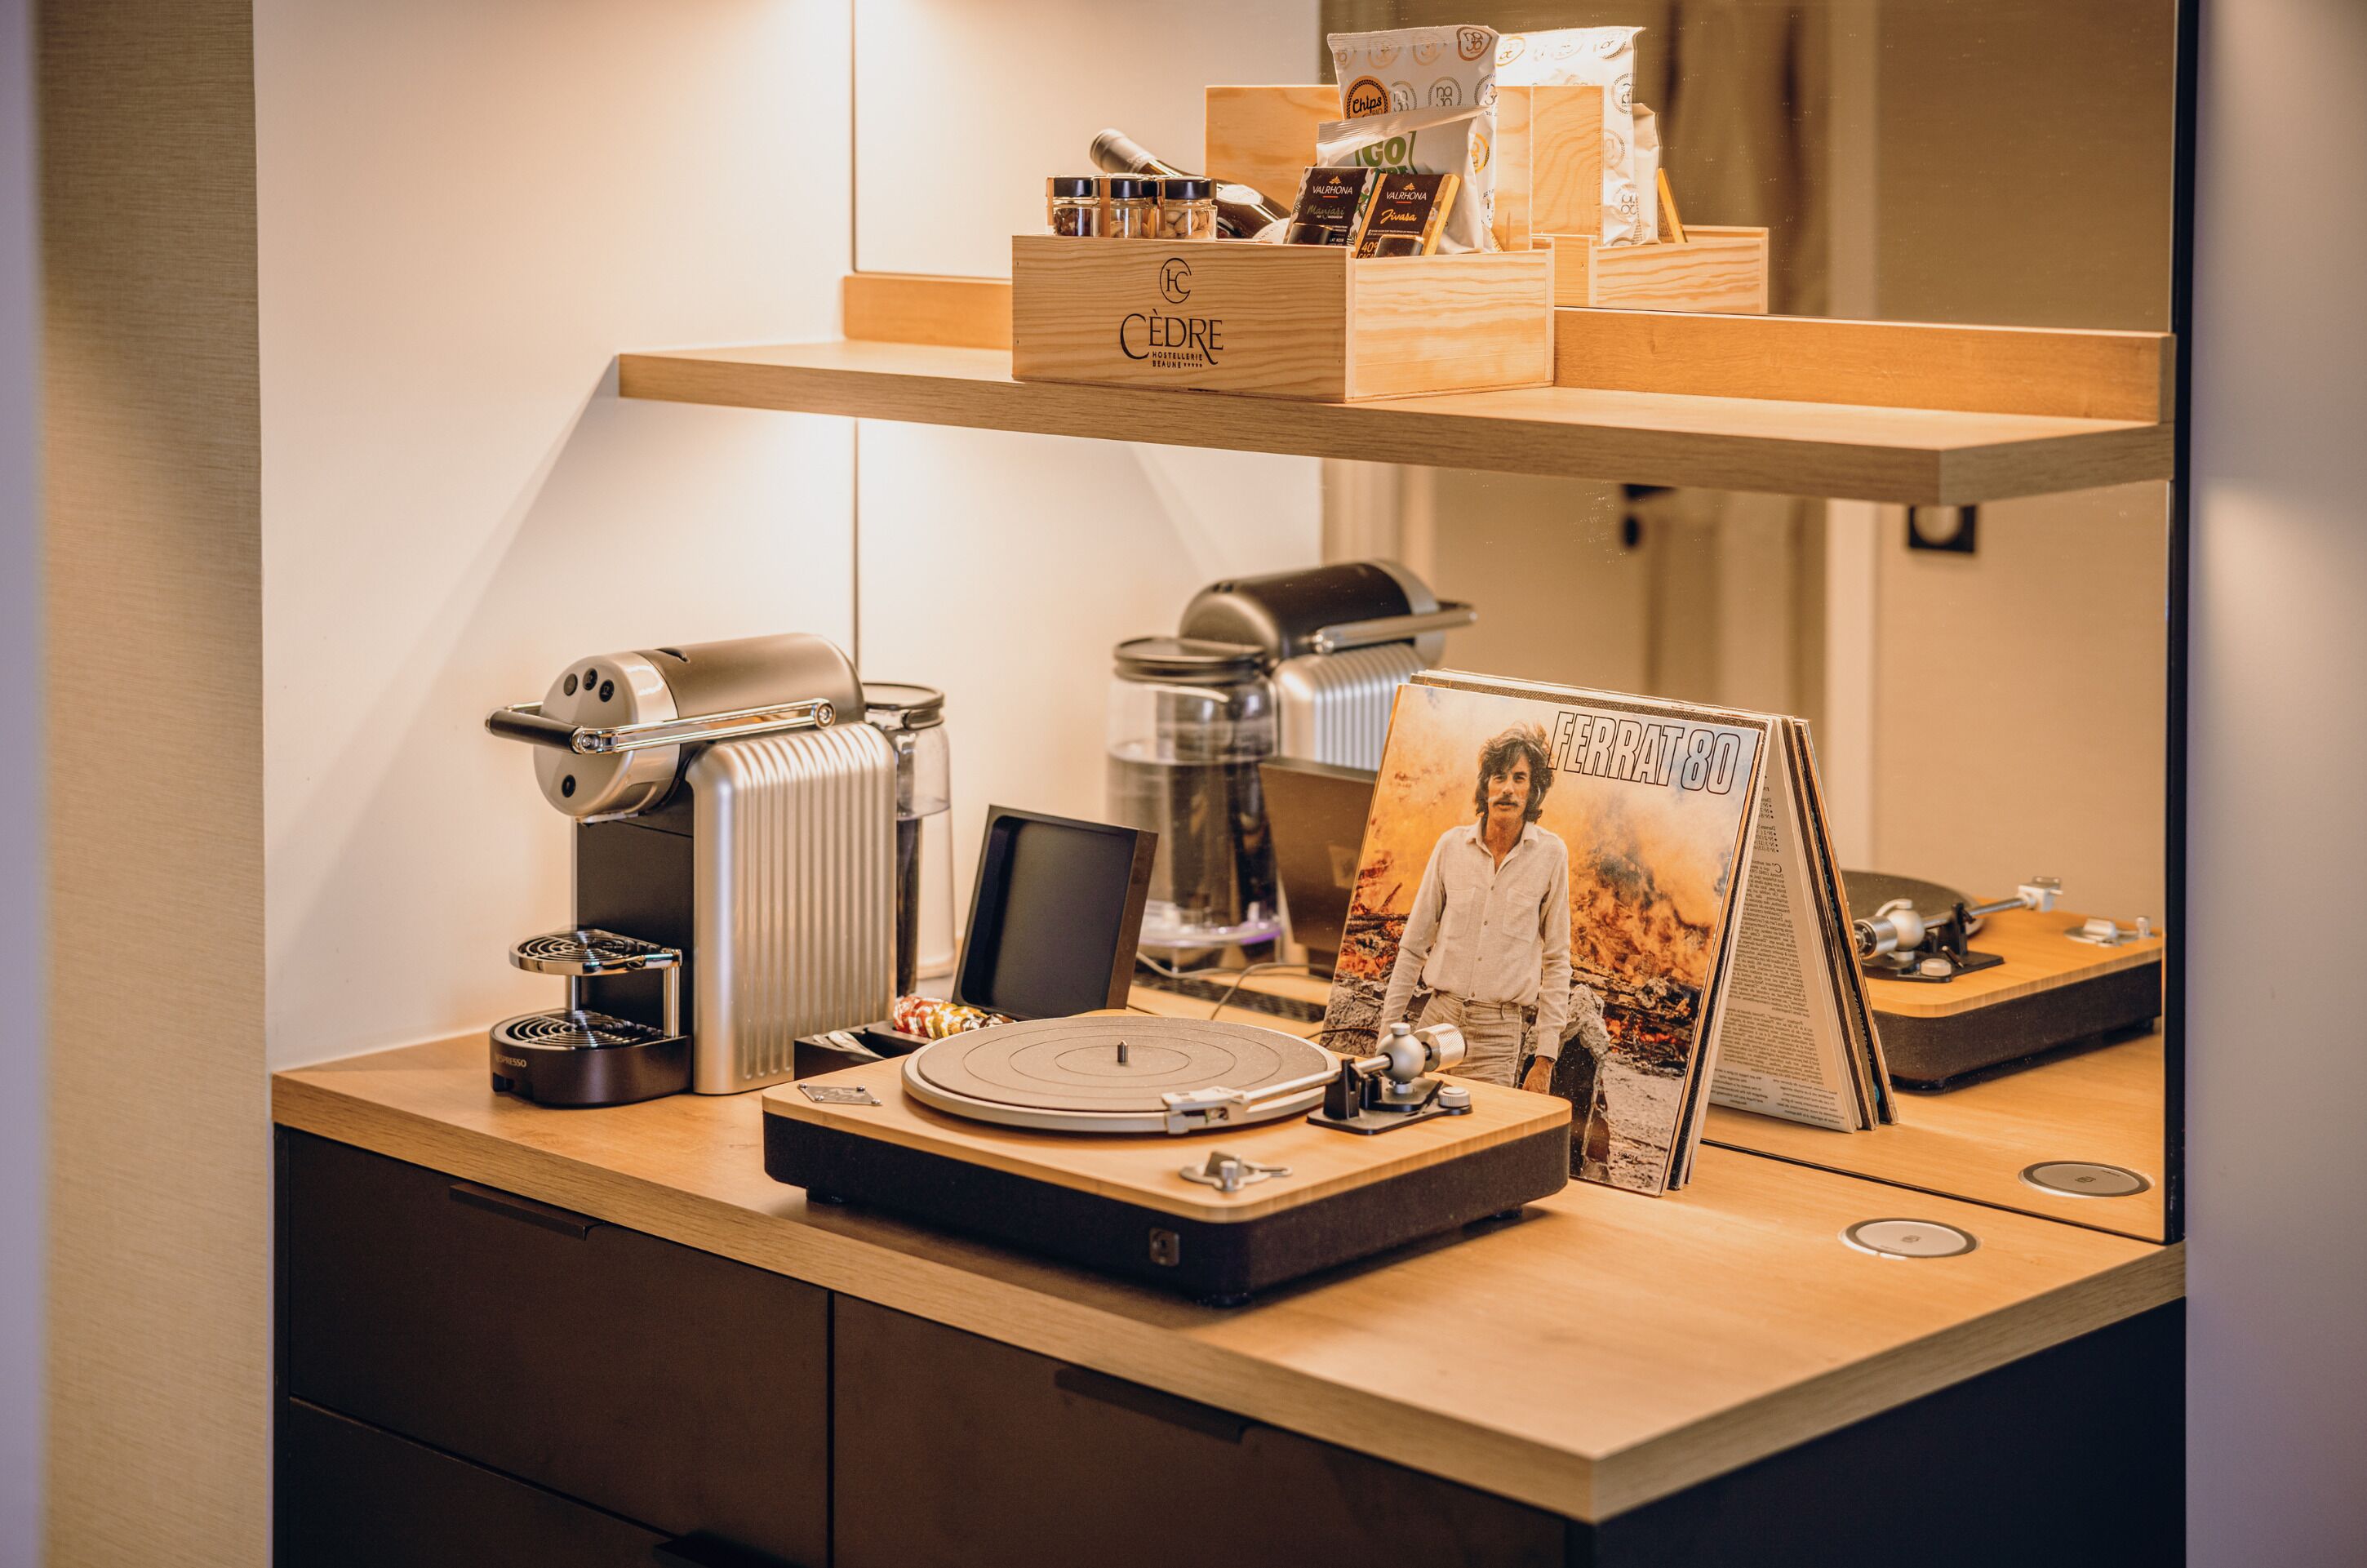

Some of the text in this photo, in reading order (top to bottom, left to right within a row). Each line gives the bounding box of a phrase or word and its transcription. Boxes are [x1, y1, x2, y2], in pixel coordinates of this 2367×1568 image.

[1352, 95, 1383, 114] Chips
[1362, 136, 1407, 167] GO
[1312, 185, 1352, 195] VALRHONA
[1386, 191, 1427, 201] VALRHONA
[1120, 309, 1224, 366] CÈDRE
[1152, 351, 1203, 361] HOSTELLERIE
[1152, 360, 1182, 368] BEAUNE
[1548, 711, 1741, 795] FERRAT 80
